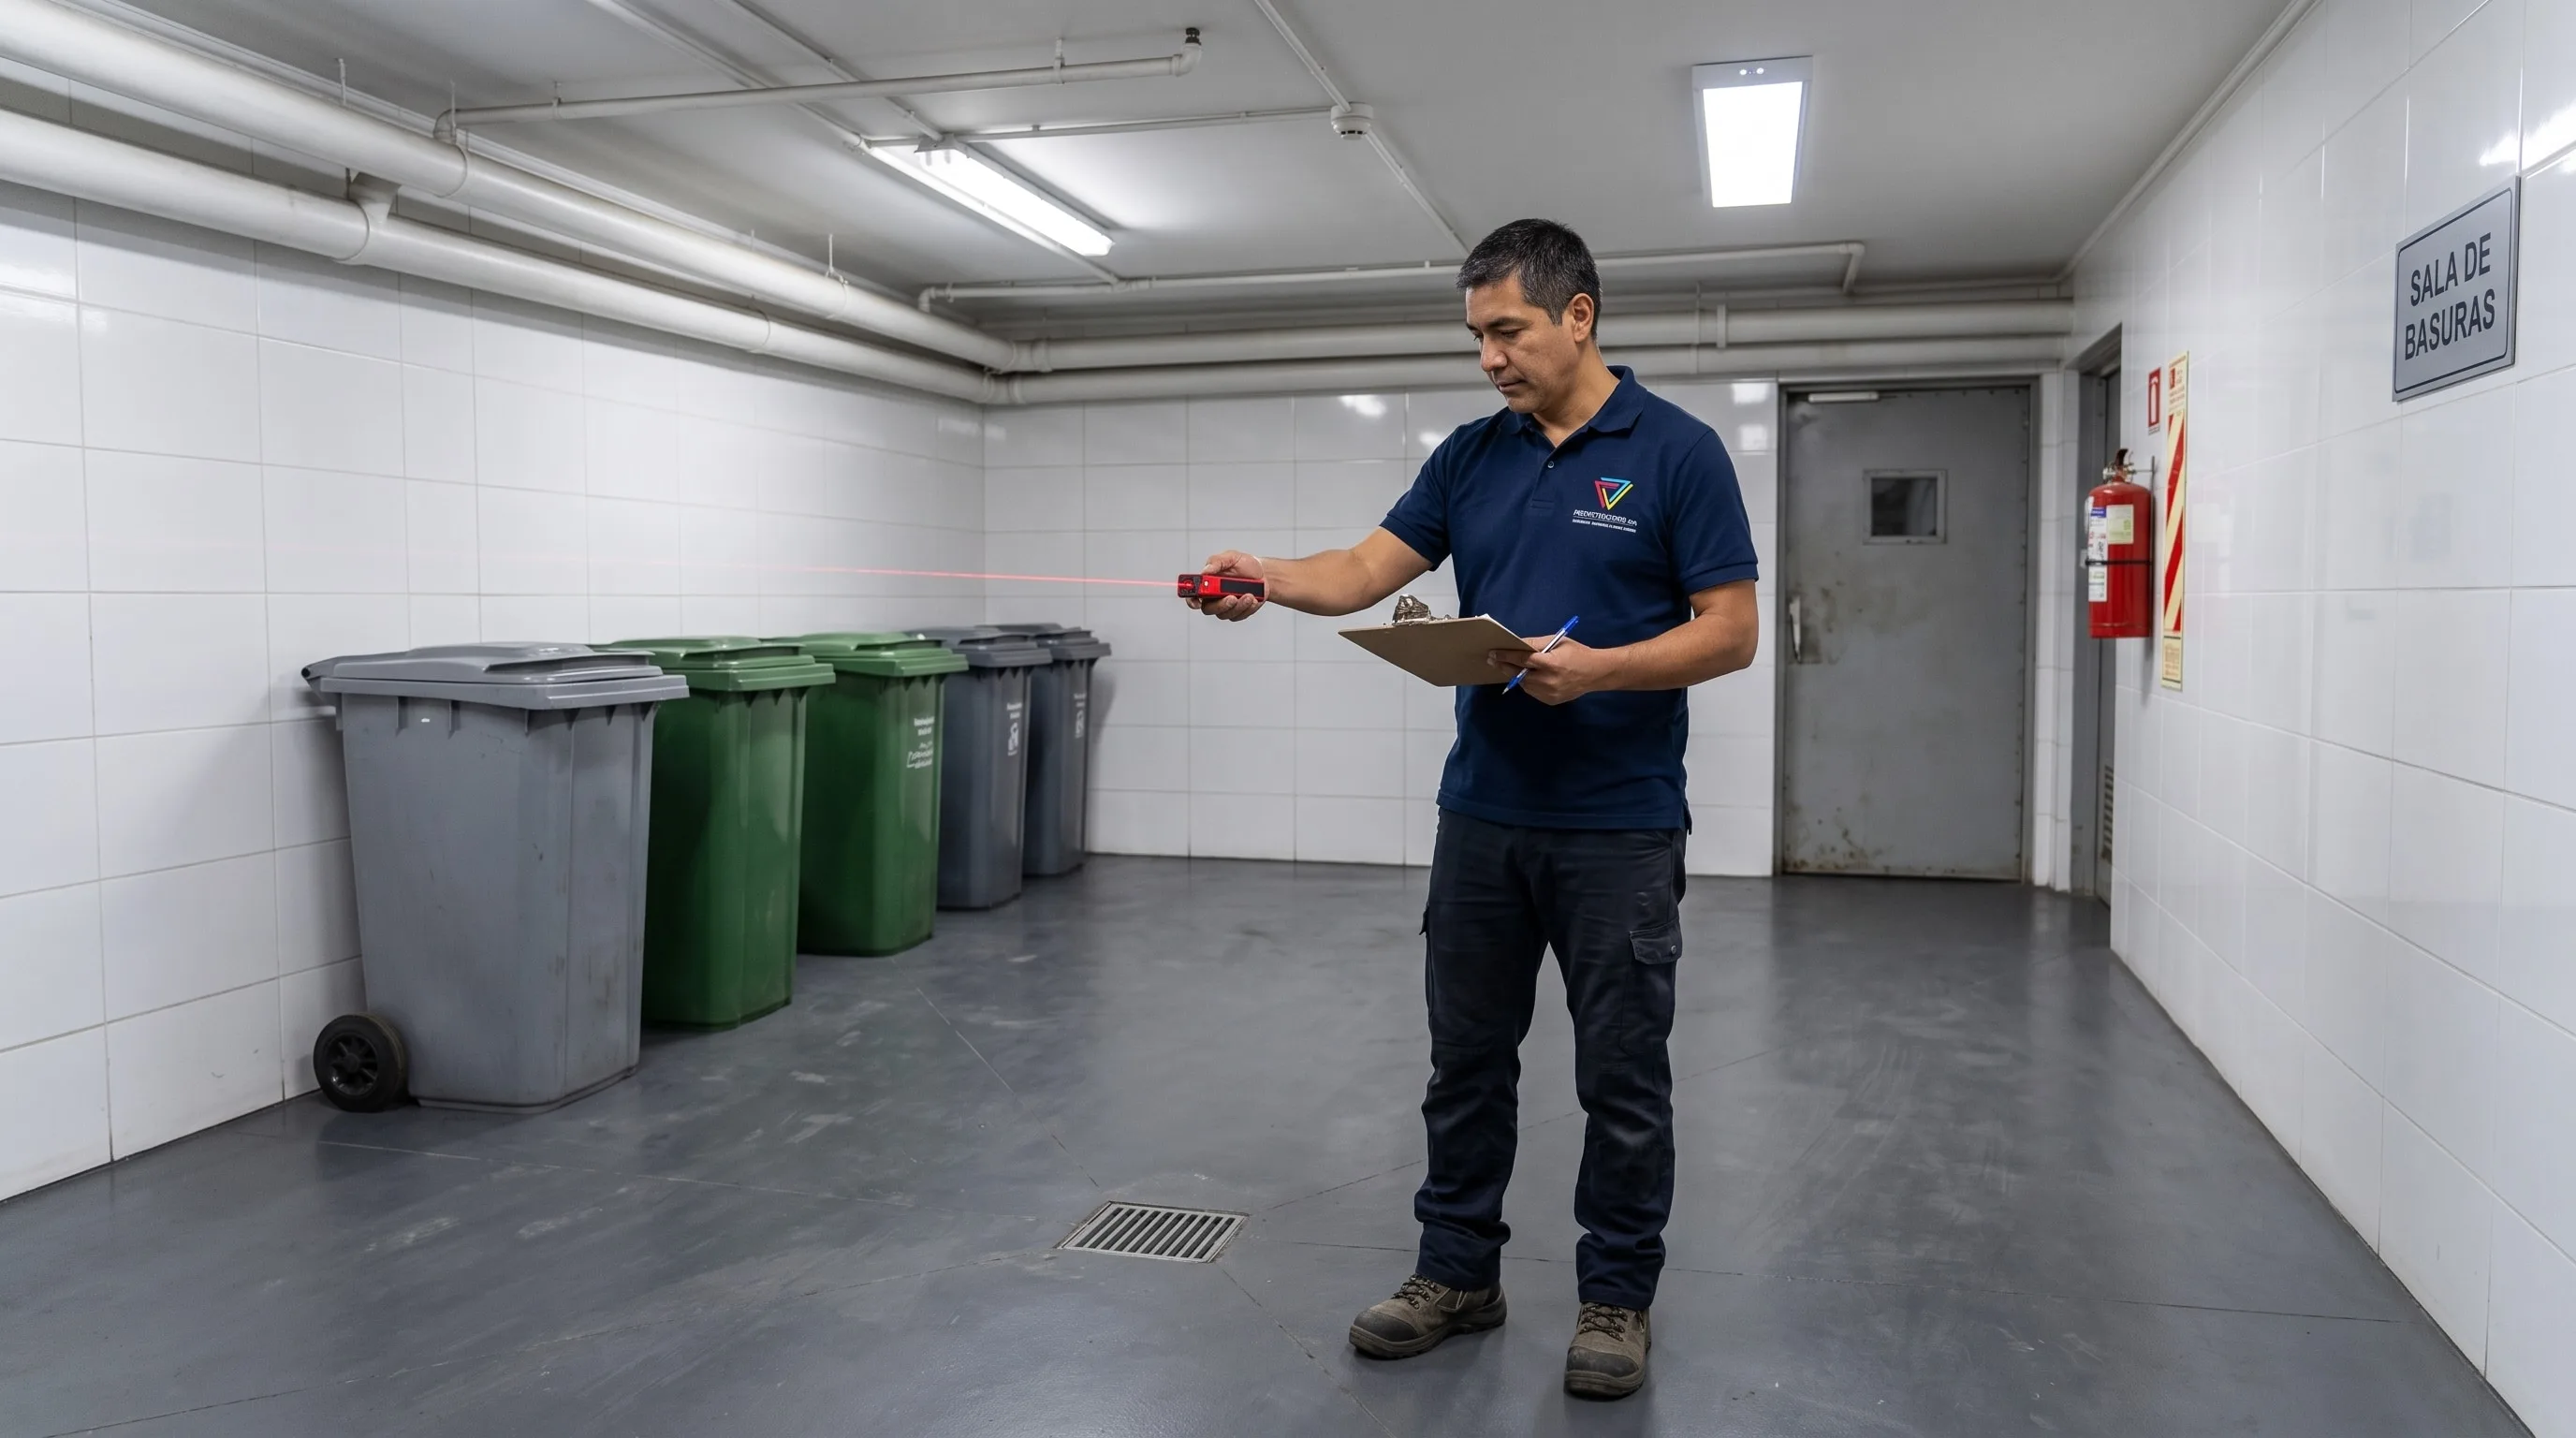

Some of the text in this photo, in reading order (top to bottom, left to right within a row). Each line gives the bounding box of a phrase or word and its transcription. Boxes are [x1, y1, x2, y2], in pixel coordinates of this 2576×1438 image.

[2410, 232, 2492, 307] SALA DE
[2405, 288, 2496, 360] BASURAS
